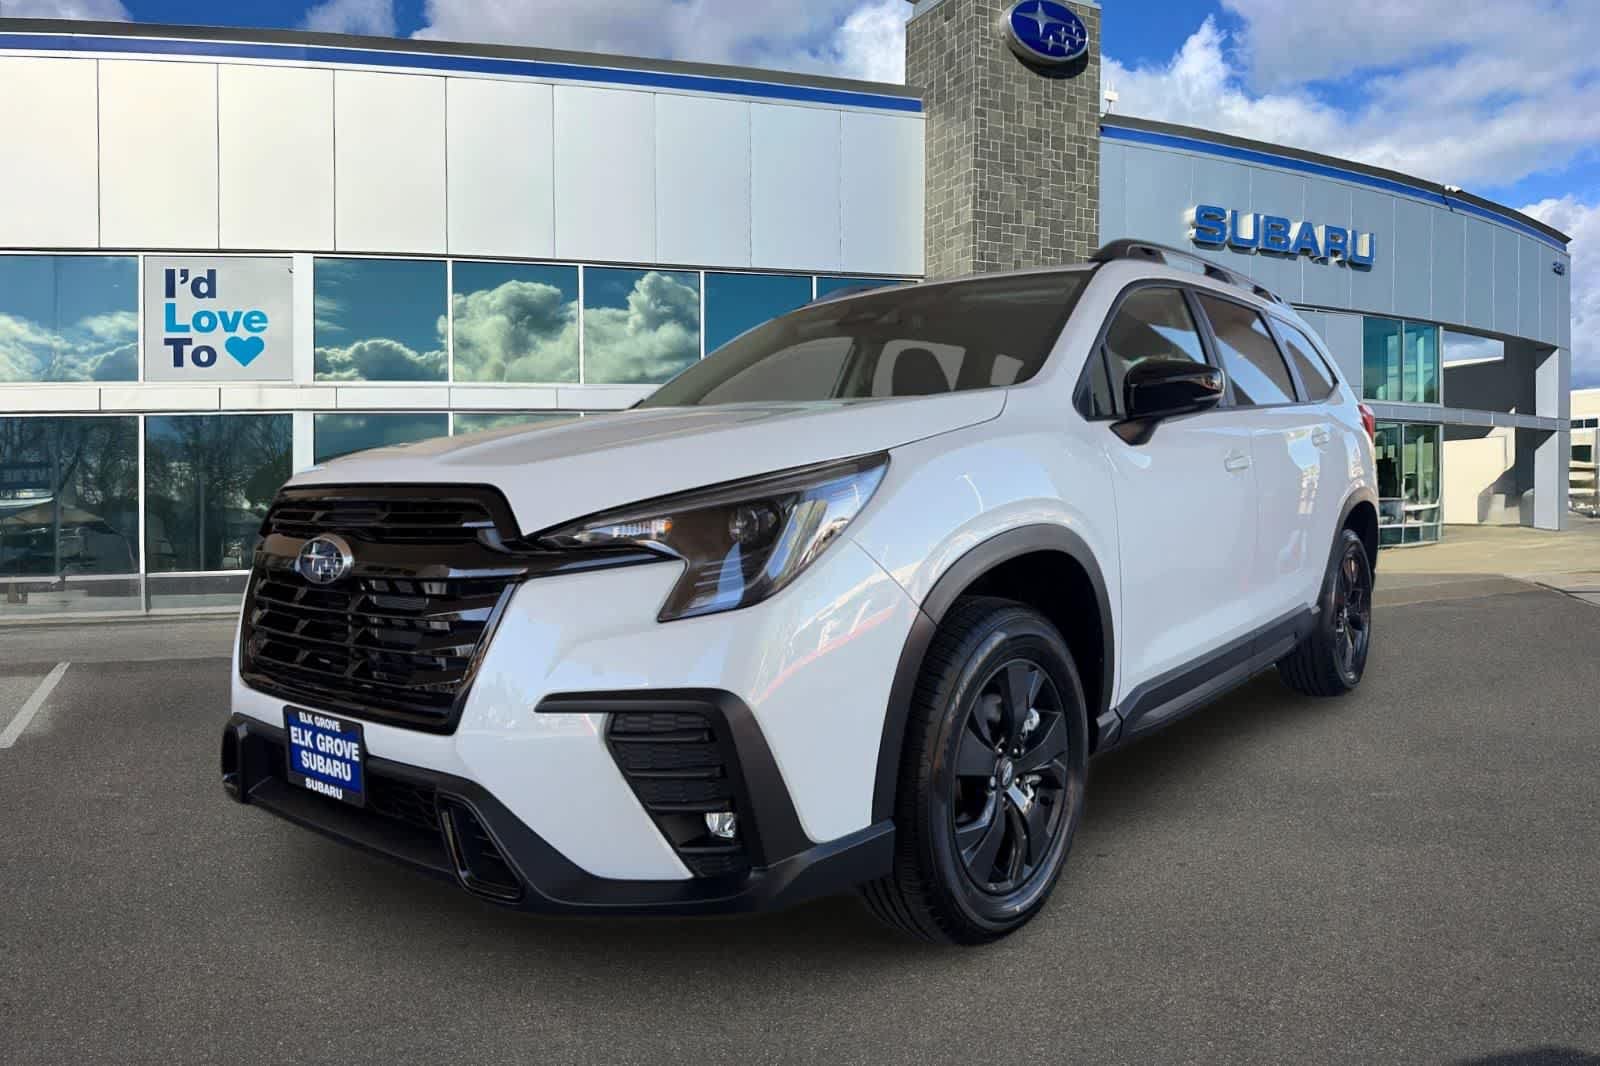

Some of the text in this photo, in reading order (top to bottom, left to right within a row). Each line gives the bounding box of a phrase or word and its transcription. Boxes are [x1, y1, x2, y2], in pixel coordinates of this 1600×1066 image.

[1193, 204, 1375, 268] SUBARU
[165, 269, 216, 299] I’d
[165, 303, 268, 333] Love
[164, 338, 217, 367] To
[299, 712, 341, 732] ELK GROVE
[290, 726, 360, 762] ELK GROVE
[301, 750, 351, 781] SUBARU
[305, 778, 343, 800] SUBARU
